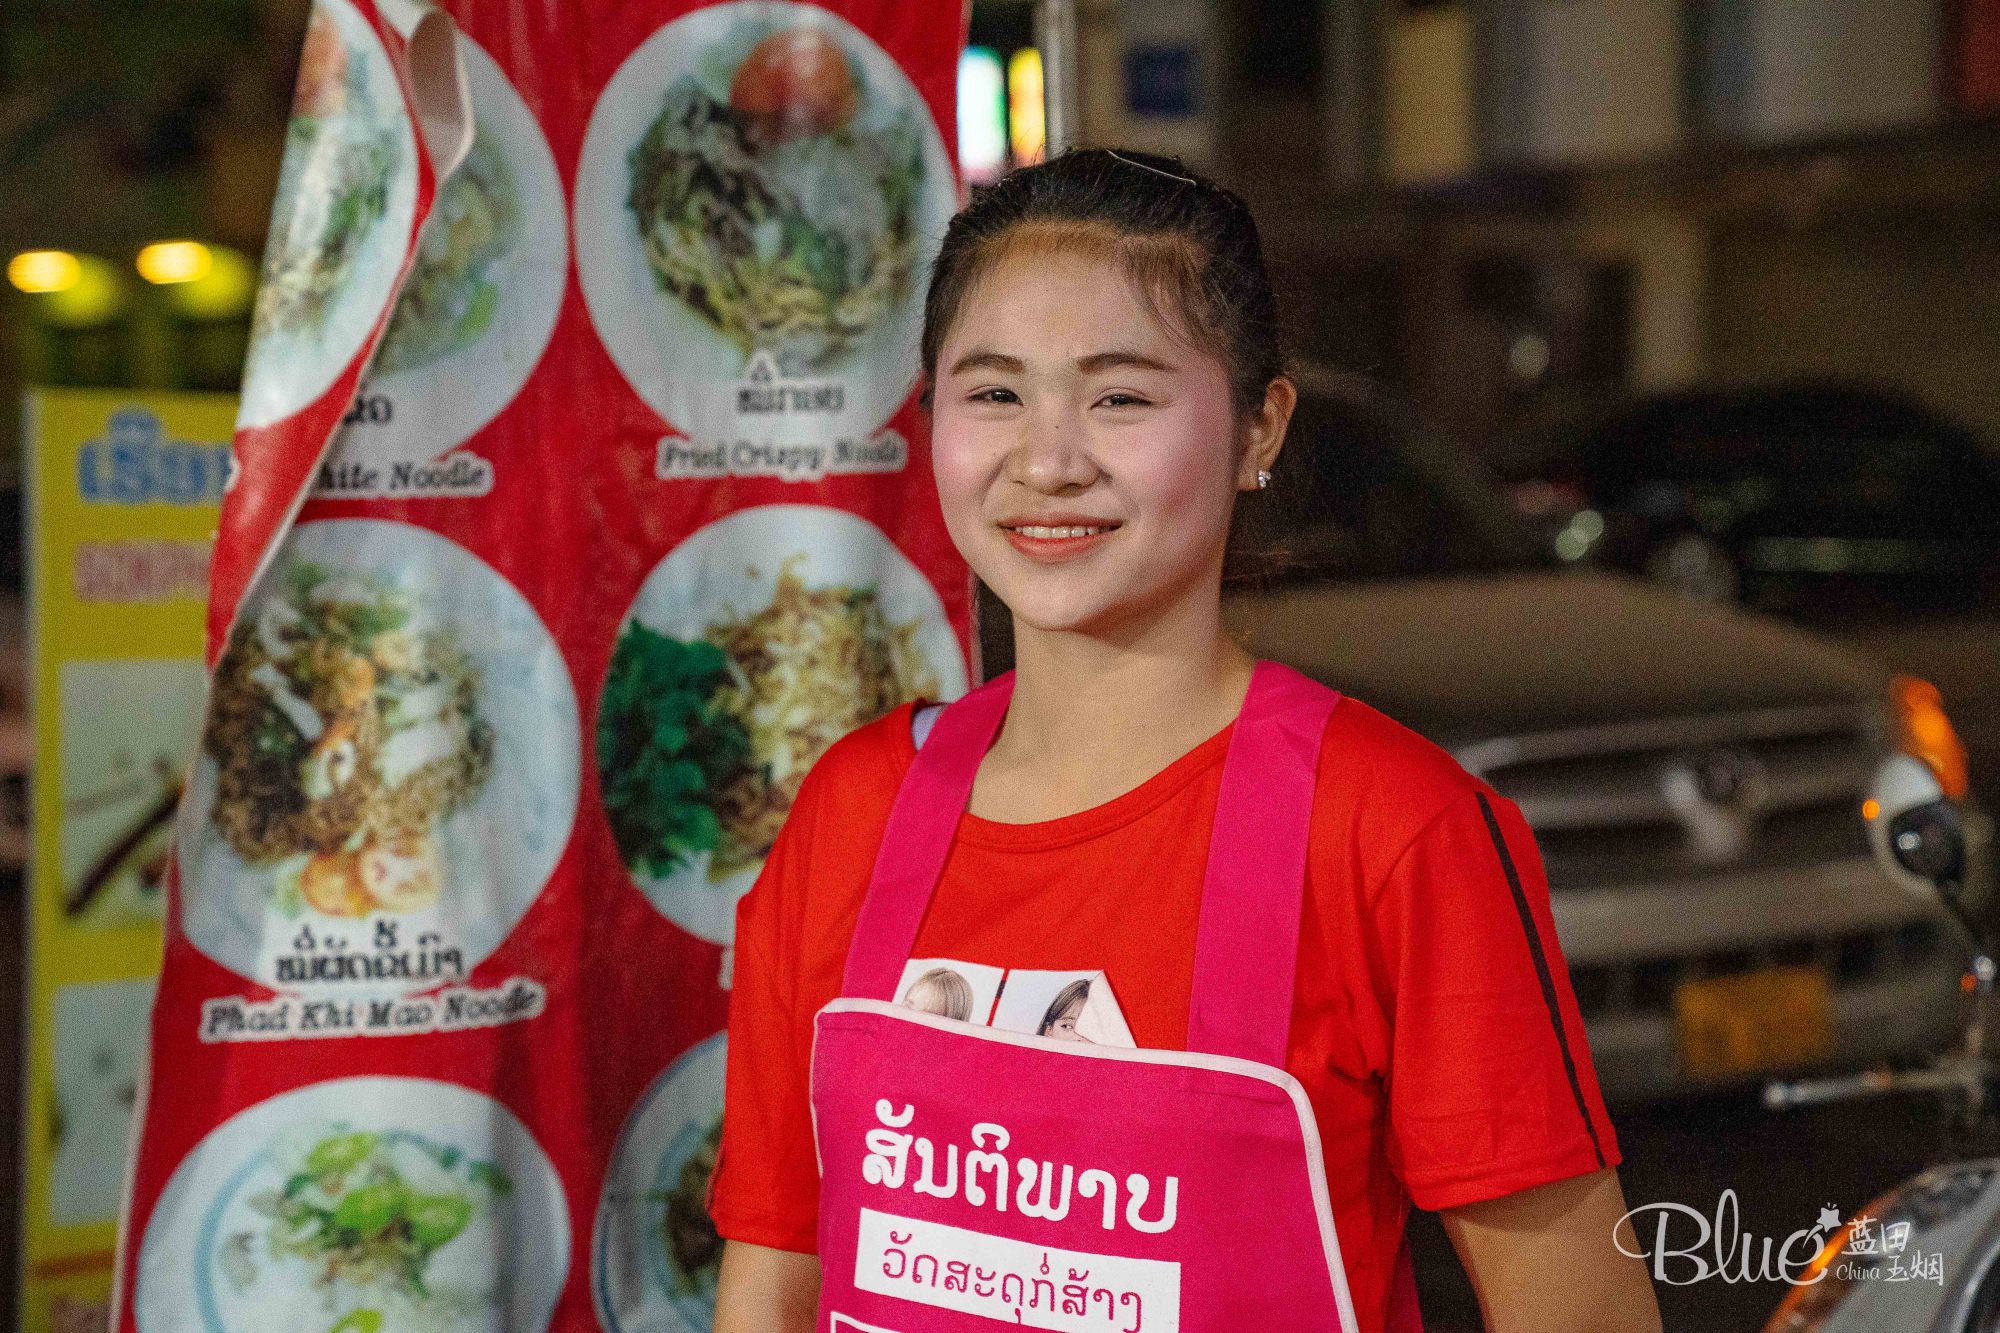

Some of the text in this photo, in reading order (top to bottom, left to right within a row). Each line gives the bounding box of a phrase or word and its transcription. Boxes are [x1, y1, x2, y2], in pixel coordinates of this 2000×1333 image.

[318, 460, 486, 491] hite Noodle
[208, 983, 538, 1035] Phad Khi Mao Noodle
[861, 1098, 1179, 1235] ສັນຕິພາບ
[882, 1230, 1142, 1333] ວັດສະດຸກໍ່ສ້າງ
